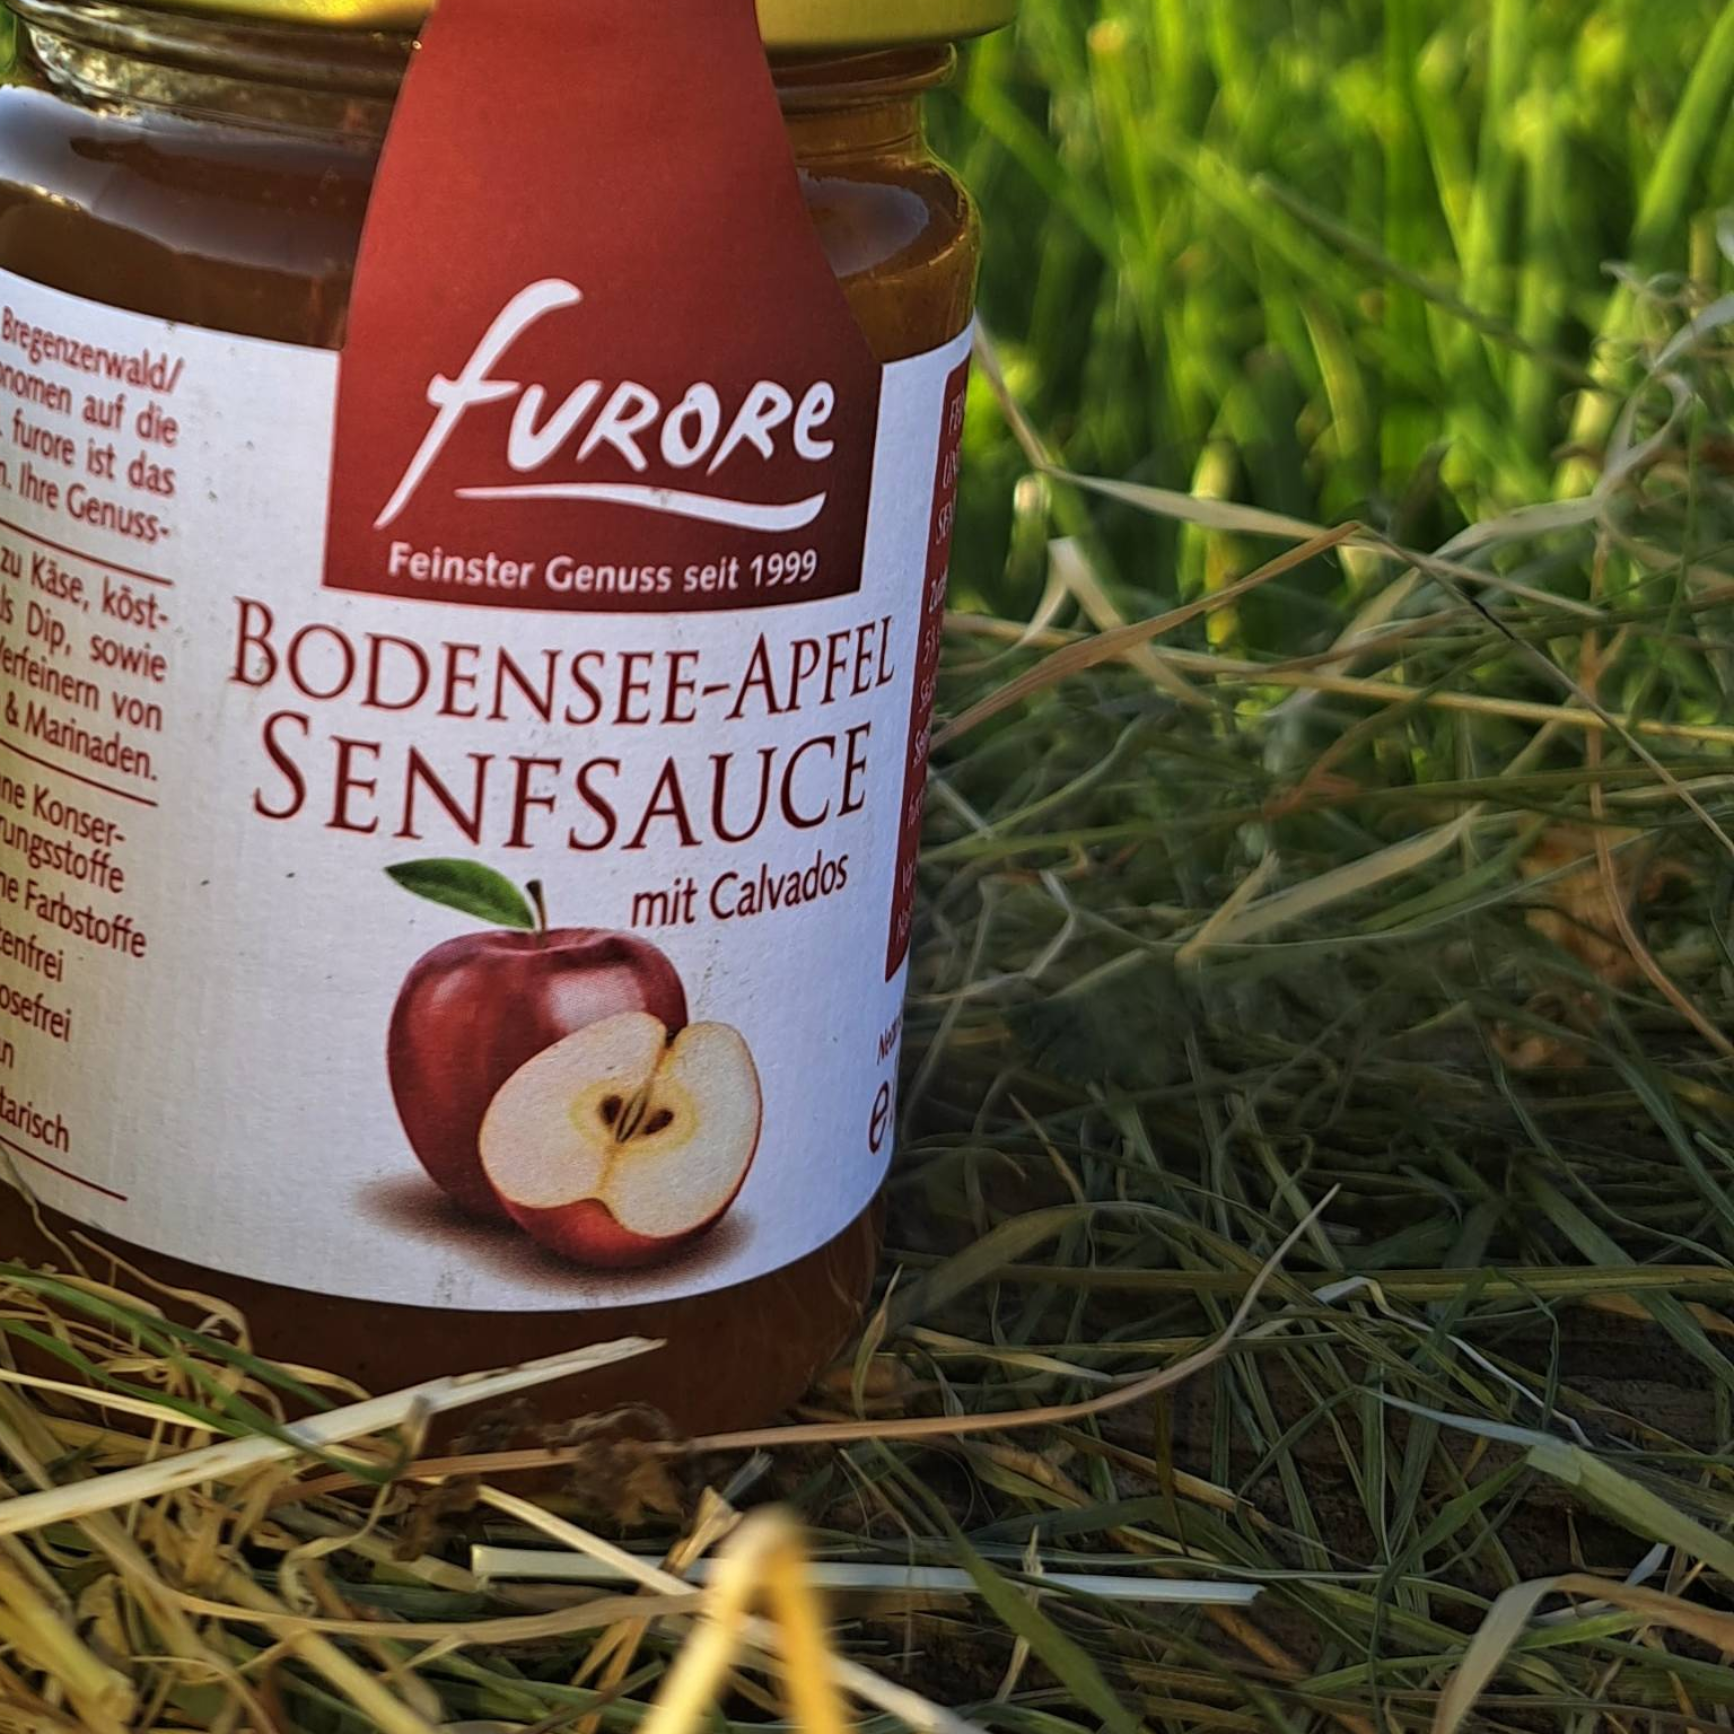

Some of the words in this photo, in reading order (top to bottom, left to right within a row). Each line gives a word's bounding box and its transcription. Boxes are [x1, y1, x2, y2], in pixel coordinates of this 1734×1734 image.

[12, 408, 76, 466] furore
[87, 438, 116, 480] ist
[128, 451, 176, 496] das
[83, 394, 125, 431] auf
[136, 401, 178, 446] die
[19, 462, 59, 509] Ihre
[67, 483, 171, 544] Genuss-
[0, 547, 22, 579] zu
[31, 552, 89, 611] Käse,
[102, 576, 169, 630] köst-
[388, 541, 534, 588] Feinster
[546, 555, 671, 593] Genuss
[684, 556, 739, 592] seit
[748, 547, 817, 588] 1999
[27, 601, 72, 656] Dip,
[90, 634, 167, 682] sowie
[229, 595, 896, 727] BODENSEE-APFEL
[5, 691, 19, 728] &
[24, 701, 158, 781] Marinaden.
[112, 691, 162, 731] von
[33, 784, 126, 847] Konser-
[254, 709, 871, 853] SENFSAUCE
[25, 879, 147, 958] Farbstoffe
[631, 877, 695, 928] mit
[709, 849, 849, 922] Calvados
